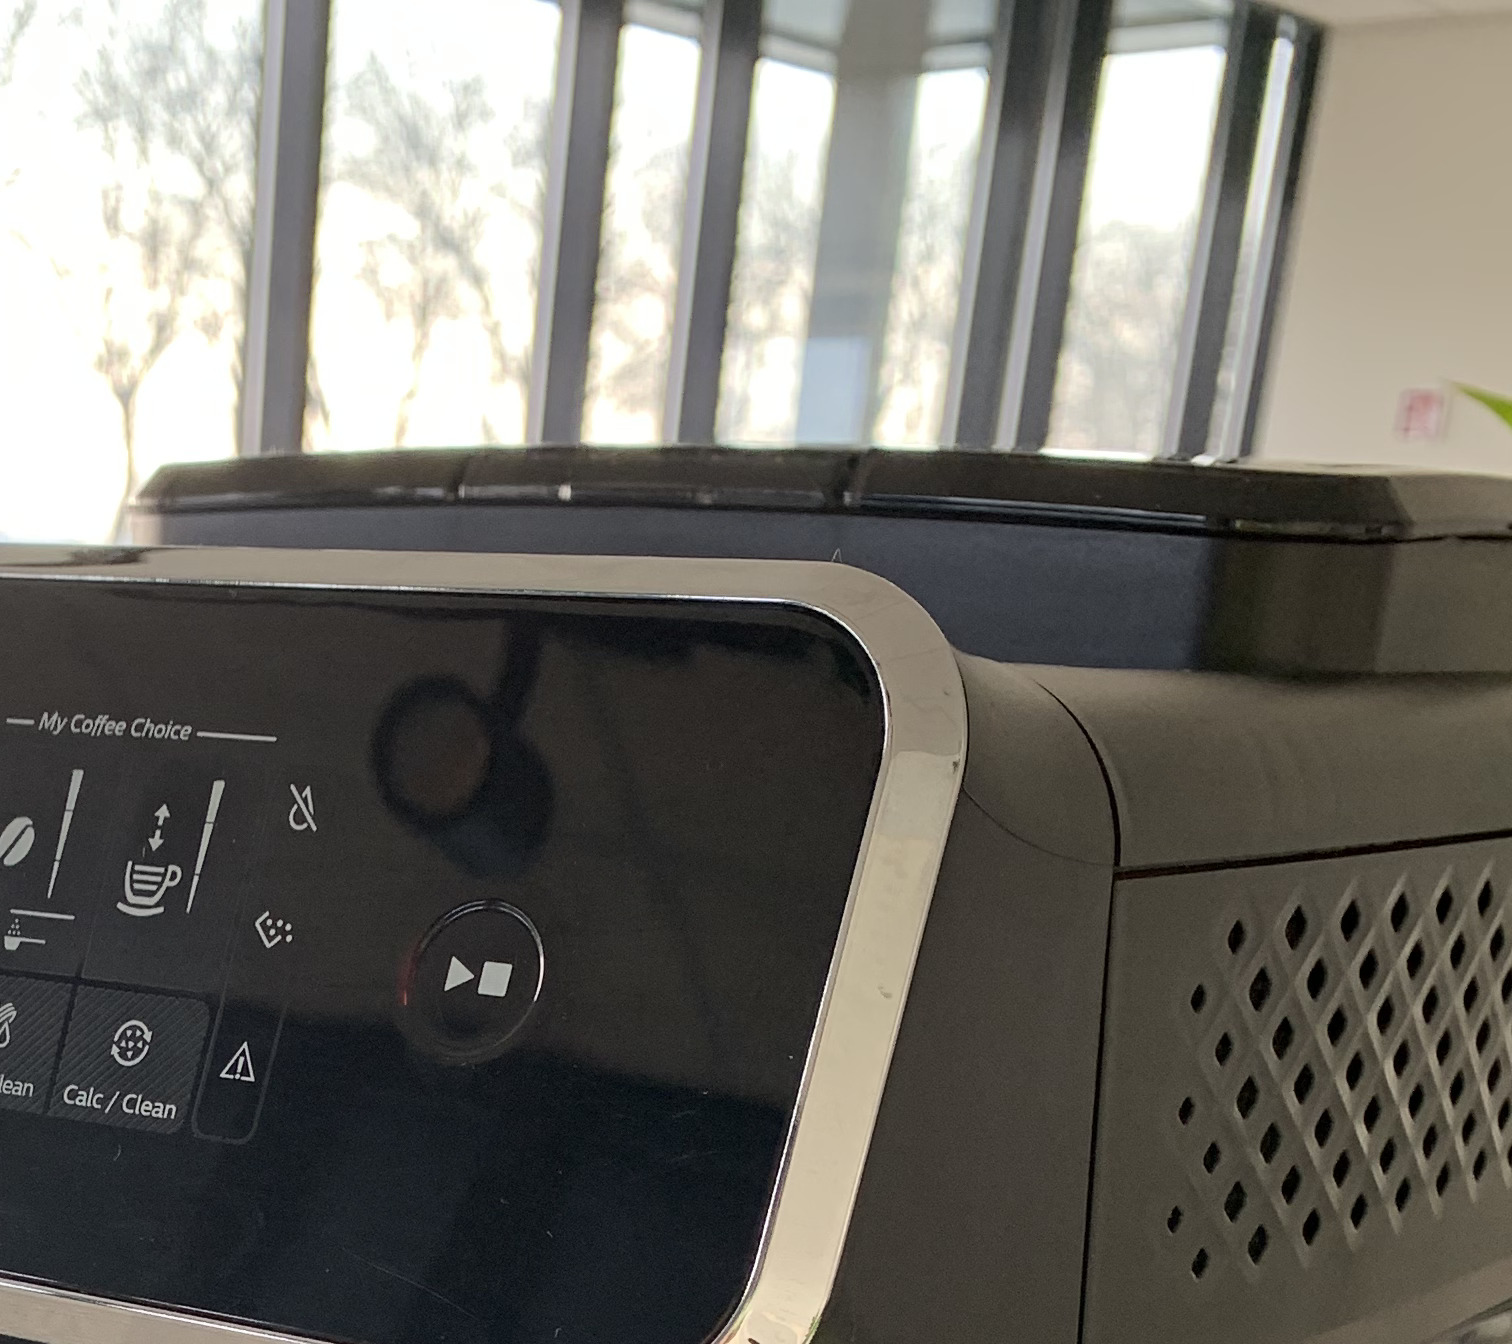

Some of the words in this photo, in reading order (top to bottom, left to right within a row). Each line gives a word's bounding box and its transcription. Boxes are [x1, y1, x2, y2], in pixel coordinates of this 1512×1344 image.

[38, 711, 68, 736] My
[69, 713, 127, 737] Coffee
[130, 717, 193, 741] Choice
[63, 1084, 104, 1110] Calc
[122, 1093, 177, 1120] Clean
